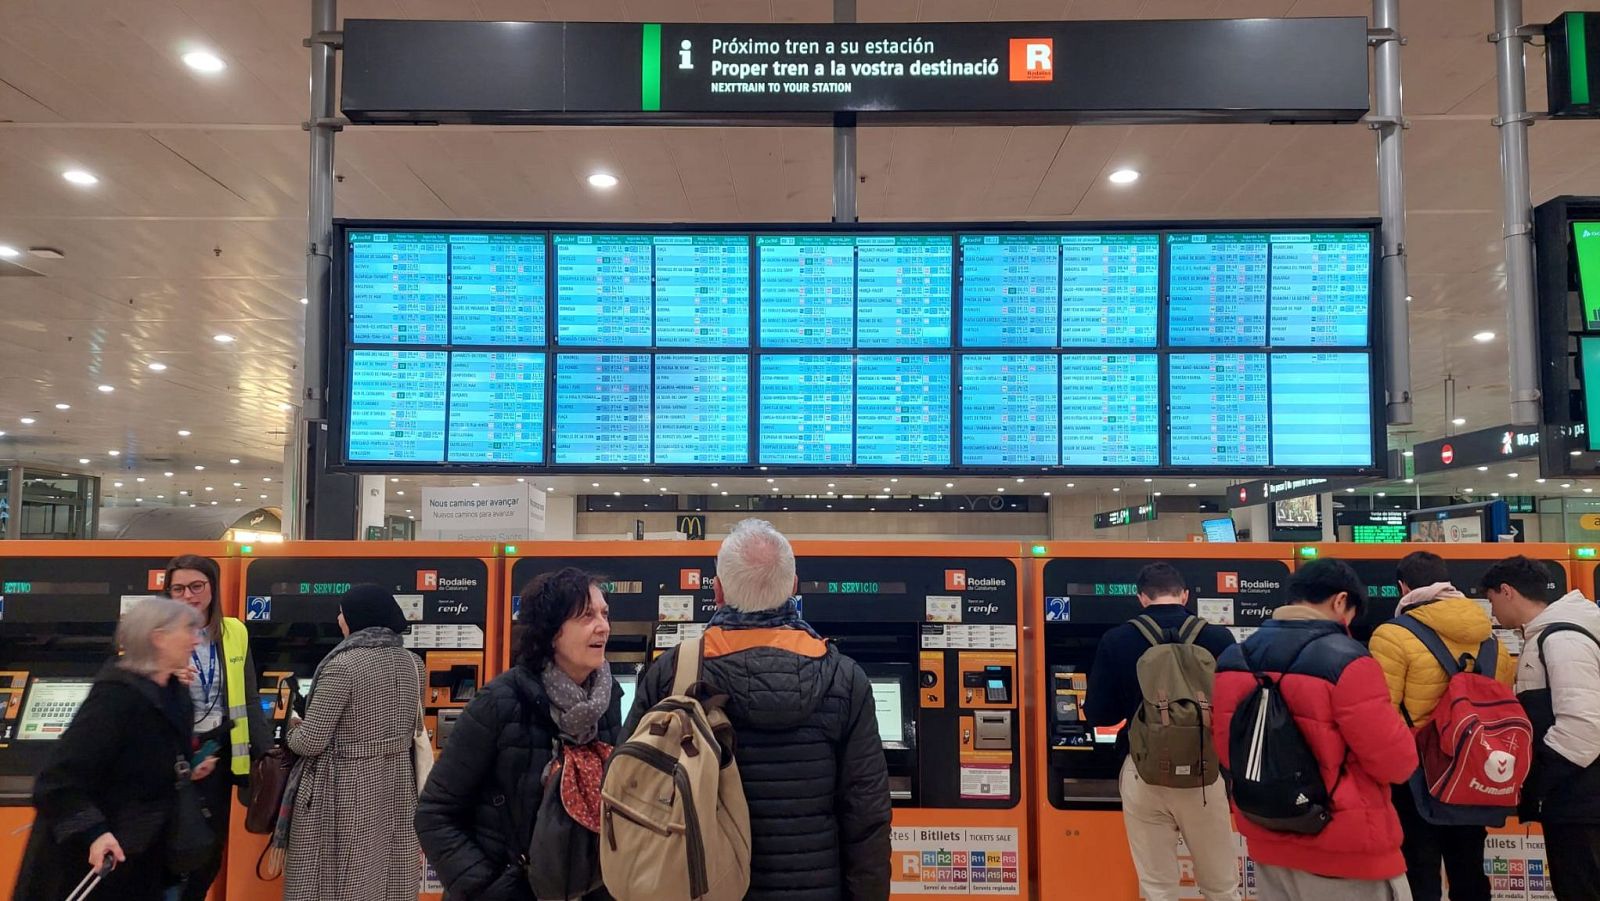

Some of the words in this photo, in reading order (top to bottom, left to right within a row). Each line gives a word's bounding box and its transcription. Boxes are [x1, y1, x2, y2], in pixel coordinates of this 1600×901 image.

[712, 38, 779, 55] Próximo
[785, 40, 819, 55] tren
[826, 43, 836, 55] a
[840, 43, 859, 55] su
[865, 38, 935, 55] estación
[1027, 44, 1052, 70] R
[711, 60, 768, 79] Proper
[772, 61, 809, 76] tren
[815, 64, 826, 76] a
[830, 59, 846, 76] la
[850, 61, 904, 76] vostra
[910, 58, 999, 76] destinació
[768, 83, 781, 93] TO
[784, 83, 809, 93] YOUR
[811, 83, 852, 93] STATION
[429, 499, 448, 508] Nous
[449, 499, 475, 508] camins
[476, 499, 488, 509] per
[490, 498, 520, 508] avançar
[433, 511, 454, 519] Nuevos
[455, 511, 478, 519] caminos
[479, 511, 491, 519] para
[425, 573, 436, 586] R
[439, 578, 477, 586] Rodalies
[688, 572, 700, 585] R
[953, 572, 966, 586] R
[967, 578, 1006, 586] Rodalies
[1225, 575, 1238, 588] R
[300, 583, 310, 593] EN
[828, 582, 838, 593] EN
[841, 582, 879, 593] SERVICIO
[1095, 584, 1106, 594] EN
[1240, 580, 1280, 589] Rodalies
[1367, 586, 1378, 597] EN
[438, 602, 469, 615] renfe
[968, 603, 999, 615] renfe
[1241, 606, 1272, 619] renfe
[1469, 777, 1516, 795] hummel
[920, 830, 961, 841] Bitllets
[923, 854, 936, 863] R1
[937, 854, 951, 863] R2
[953, 854, 967, 863] R3
[971, 855, 985, 863] R11
[987, 855, 1000, 863] R12
[1003, 855, 1016, 863] R13
[903, 854, 920, 874] R
[1494, 863, 1507, 871] R2
[1510, 863, 1523, 871] R3
[923, 871, 936, 879] R4
[938, 871, 951, 879] R7
[953, 871, 967, 879] R8
[972, 871, 985, 879] R14
[988, 871, 1001, 879] R15
[1003, 871, 1016, 879] R16
[1494, 878, 1508, 887] R7
[1510, 878, 1524, 887] R8
